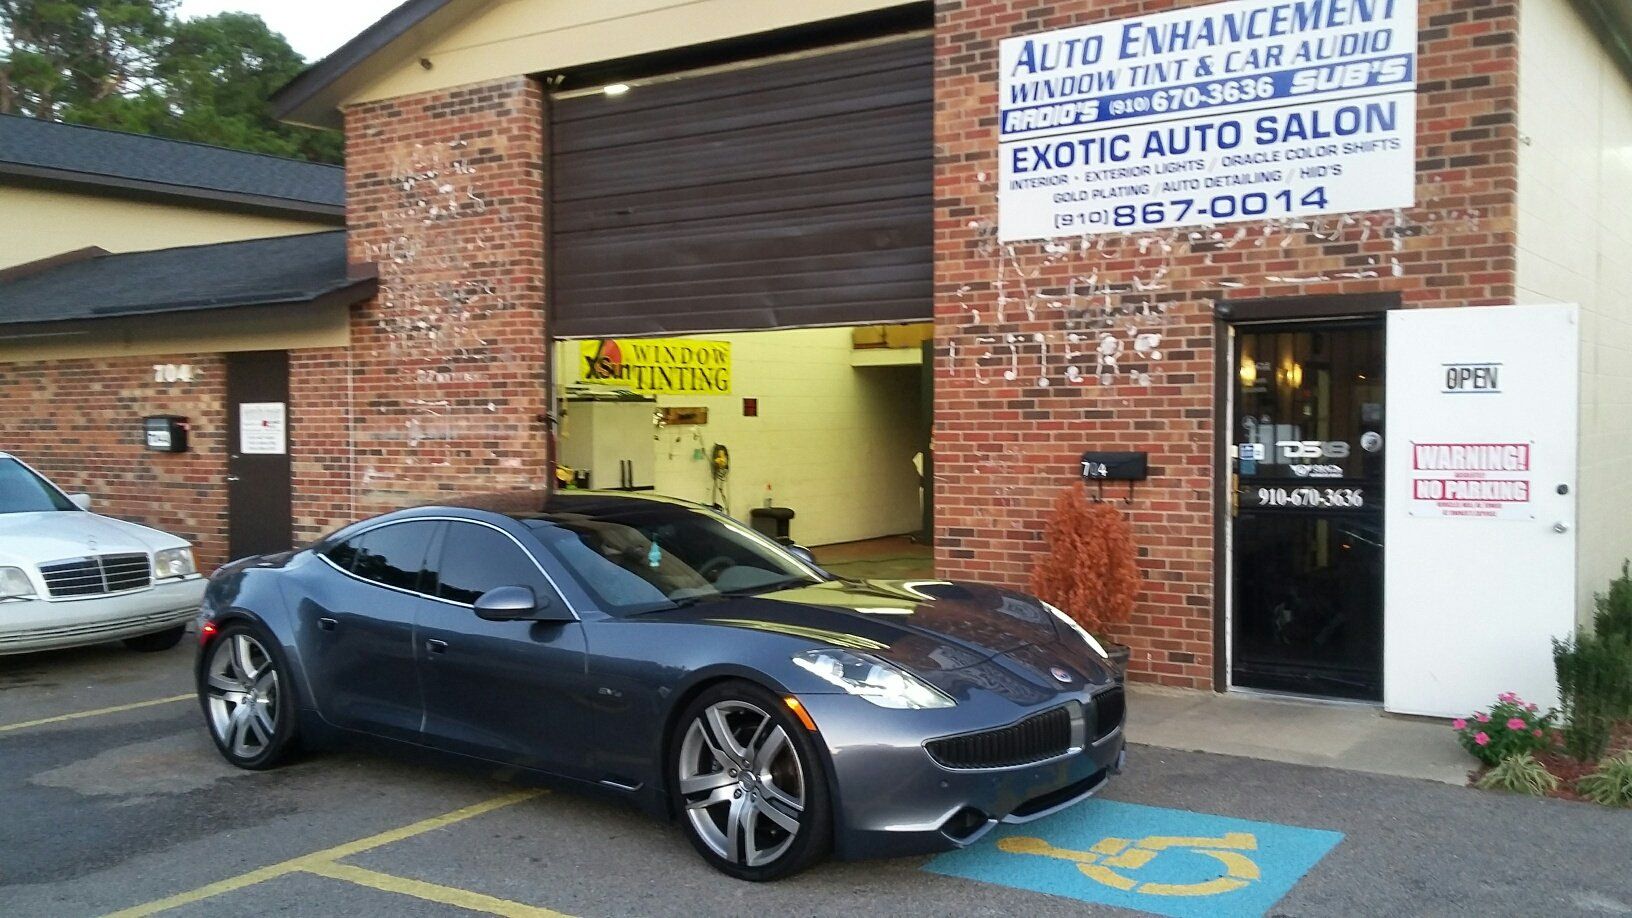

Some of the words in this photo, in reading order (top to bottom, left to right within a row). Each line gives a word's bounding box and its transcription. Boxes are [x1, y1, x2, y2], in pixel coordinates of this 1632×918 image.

[1010, 35, 1103, 76] AUTO
[1010, 68, 1121, 104] WINDOW
[1129, 58, 1188, 87] TINT
[1195, 55, 1214, 77] &
[1224, 44, 1284, 73] CAR
[1291, 29, 1392, 65] AUDIO
[1004, 100, 1100, 132] RADIO'S
[1290, 57, 1408, 94] SUB'S
[1013, 134, 1130, 173] EXOTIC
[1142, 120, 1241, 158] AUTO
[1256, 101, 1396, 145] SALON
[1010, 174, 1068, 190] INTERIOR
[1085, 165, 1150, 182] EXTERIOR
[1154, 159, 1205, 174] LIGHTS
[1221, 150, 1281, 167] ORACLE
[1285, 144, 1338, 161] COLOR
[1342, 138, 1401, 155] SHIFTS
[1053, 190, 1089, 204] GOLD
[1091, 184, 1150, 200] PLATING
[1162, 177, 1200, 192] AUTO
[1204, 170, 1282, 188] DETAILING
[1114, 186, 1328, 226] 867-0014
[632, 344, 727, 365] WINDOW
[634, 365, 729, 391] TINTING
[1447, 367, 1498, 389] OPEN
[1416, 445, 1528, 471] WARNING!
[1258, 487, 1364, 507] 910-670-3636
[1416, 480, 1443, 500] NO
[1445, 480, 1527, 500] PARKING
